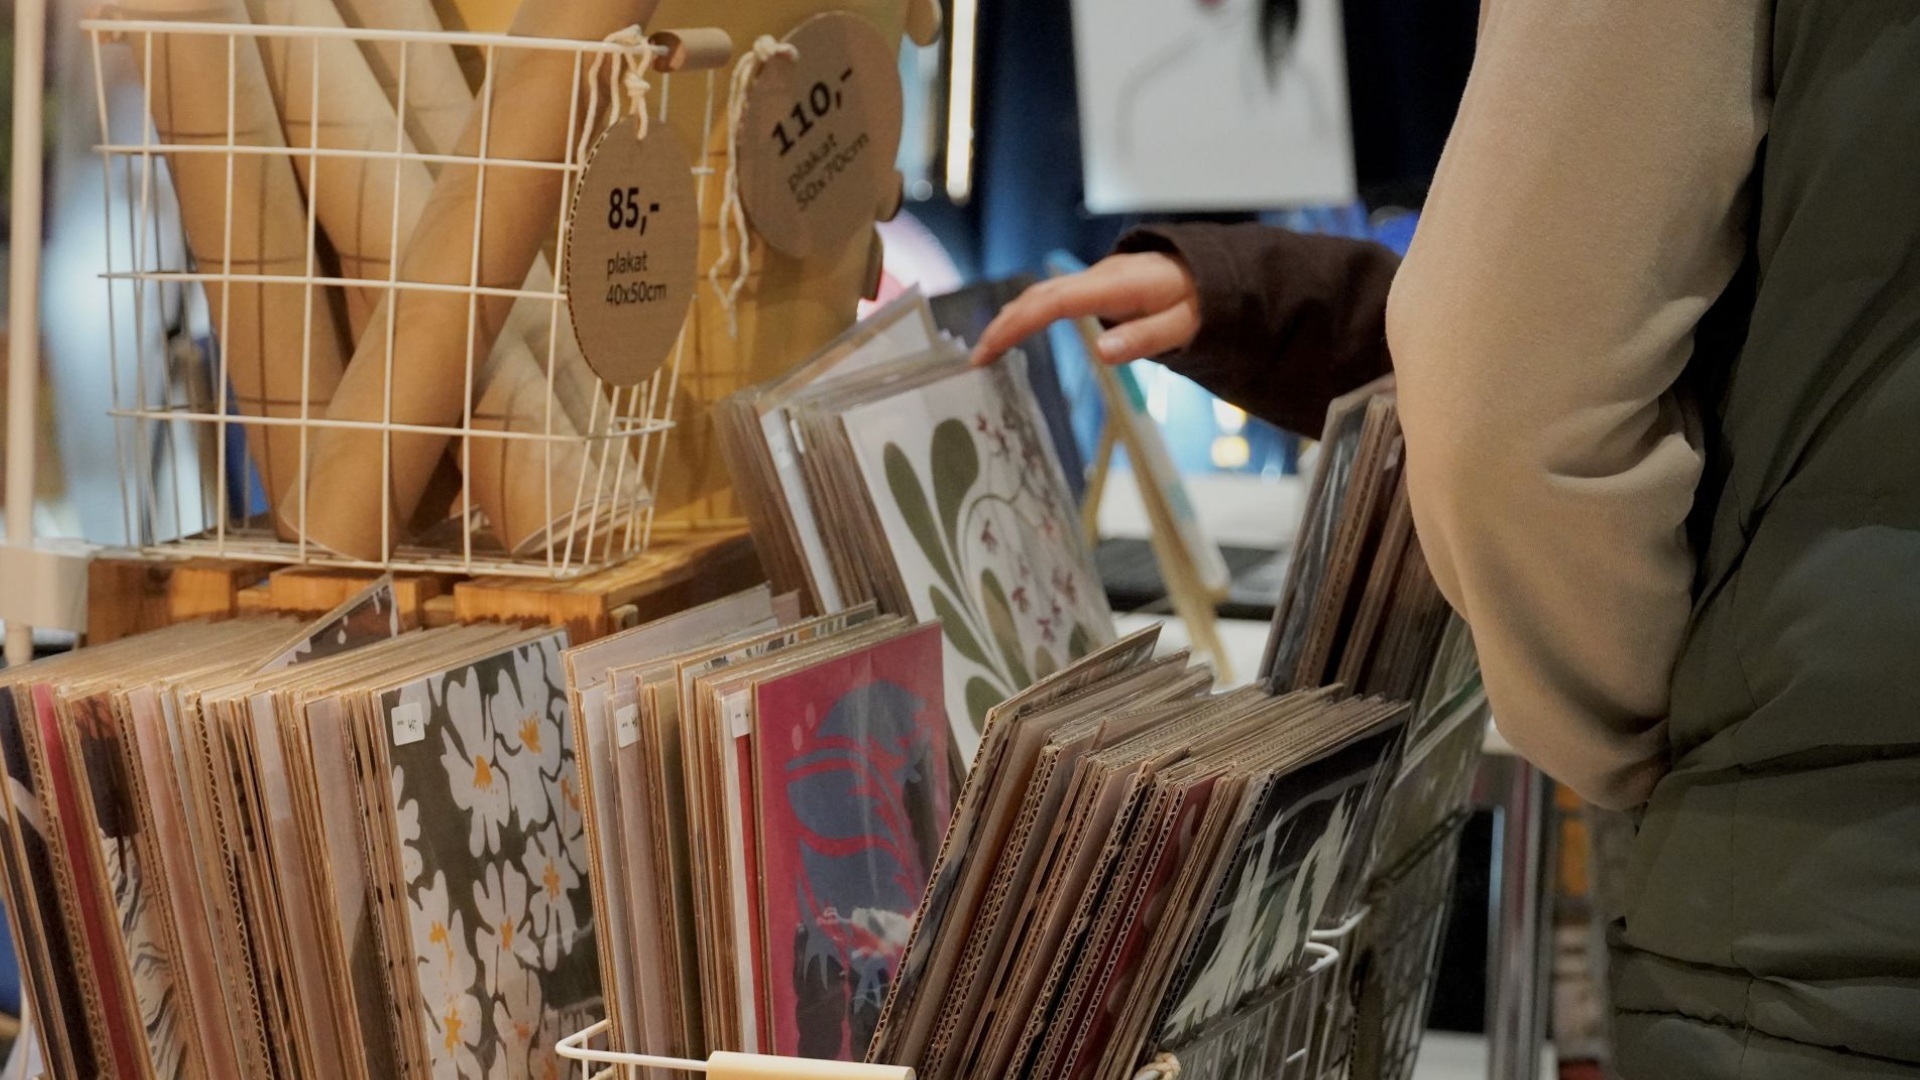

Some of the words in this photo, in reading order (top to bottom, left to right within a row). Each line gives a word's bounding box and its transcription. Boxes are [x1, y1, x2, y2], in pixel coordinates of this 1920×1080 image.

[772, 67, 853, 158] 110,-
[787, 132, 838, 193] plakat
[608, 187, 660, 236] 85,-
[606, 250, 648, 281] plakat
[606, 281, 667, 306] 40x50cm
